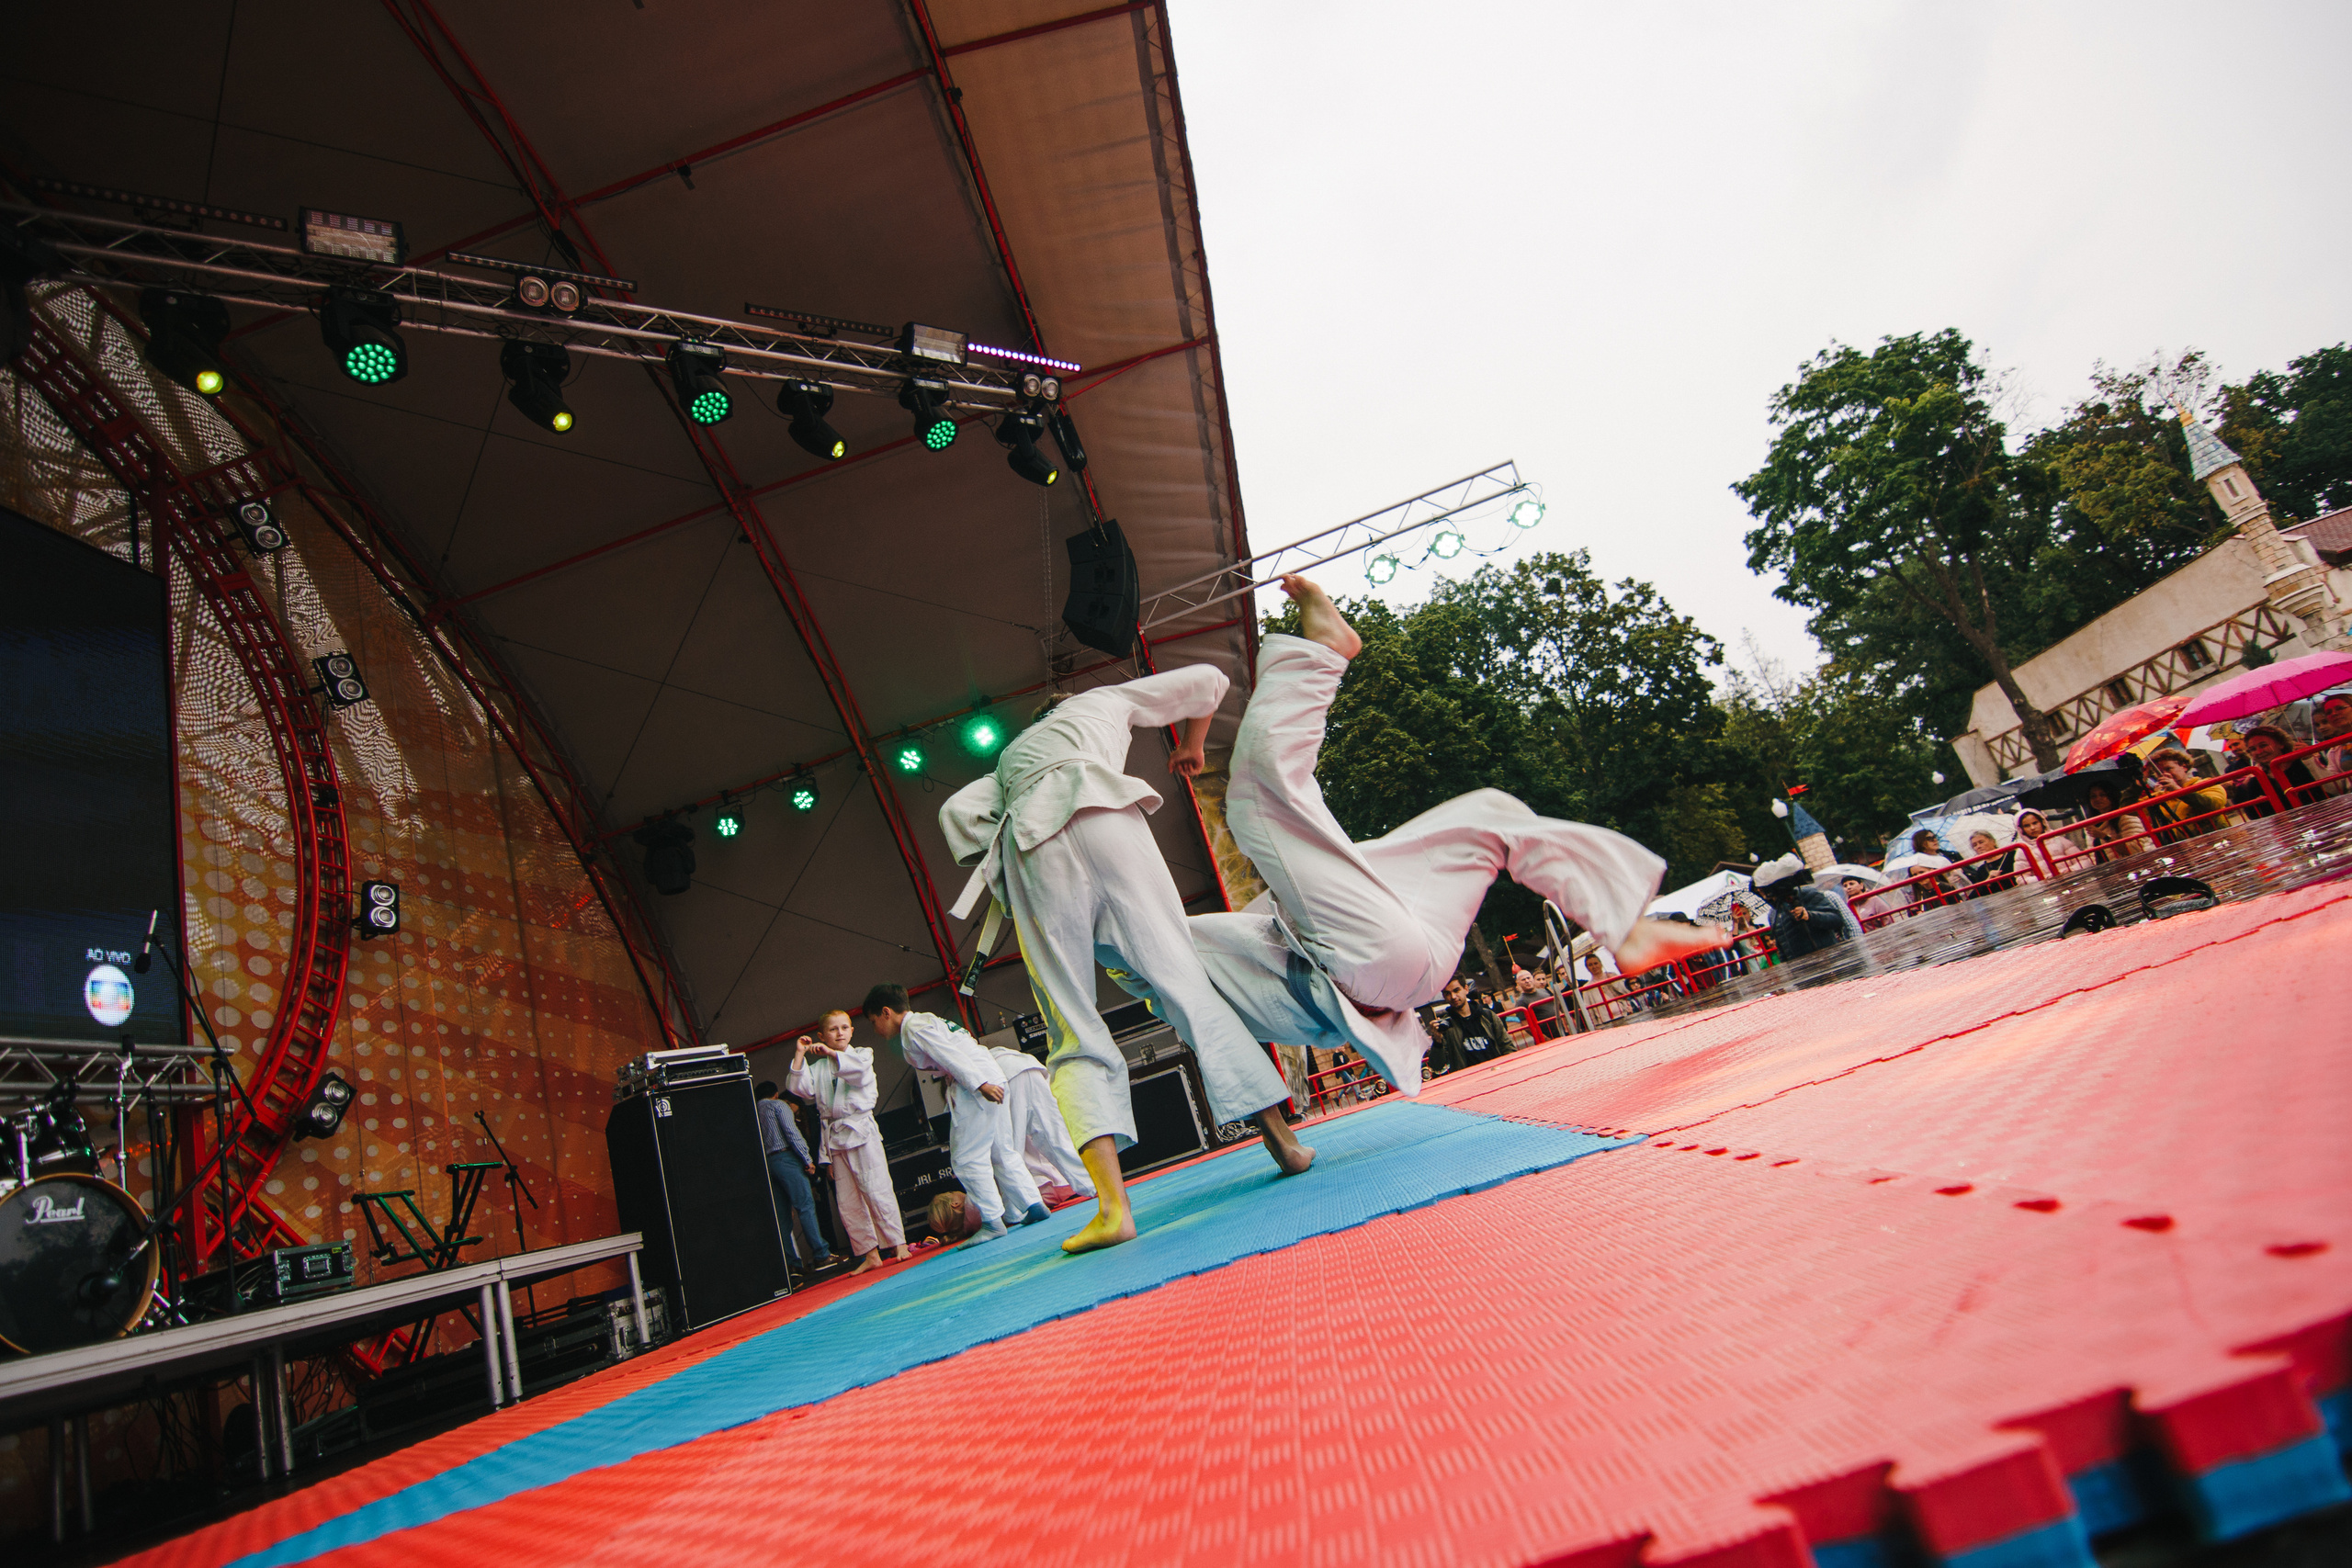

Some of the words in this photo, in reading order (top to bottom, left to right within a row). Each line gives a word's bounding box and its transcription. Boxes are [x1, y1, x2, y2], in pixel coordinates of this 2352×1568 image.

[85, 948, 103, 962] AO
[914, 1173, 937, 1187] JBL
[25, 1195, 85, 1224] Pearl
